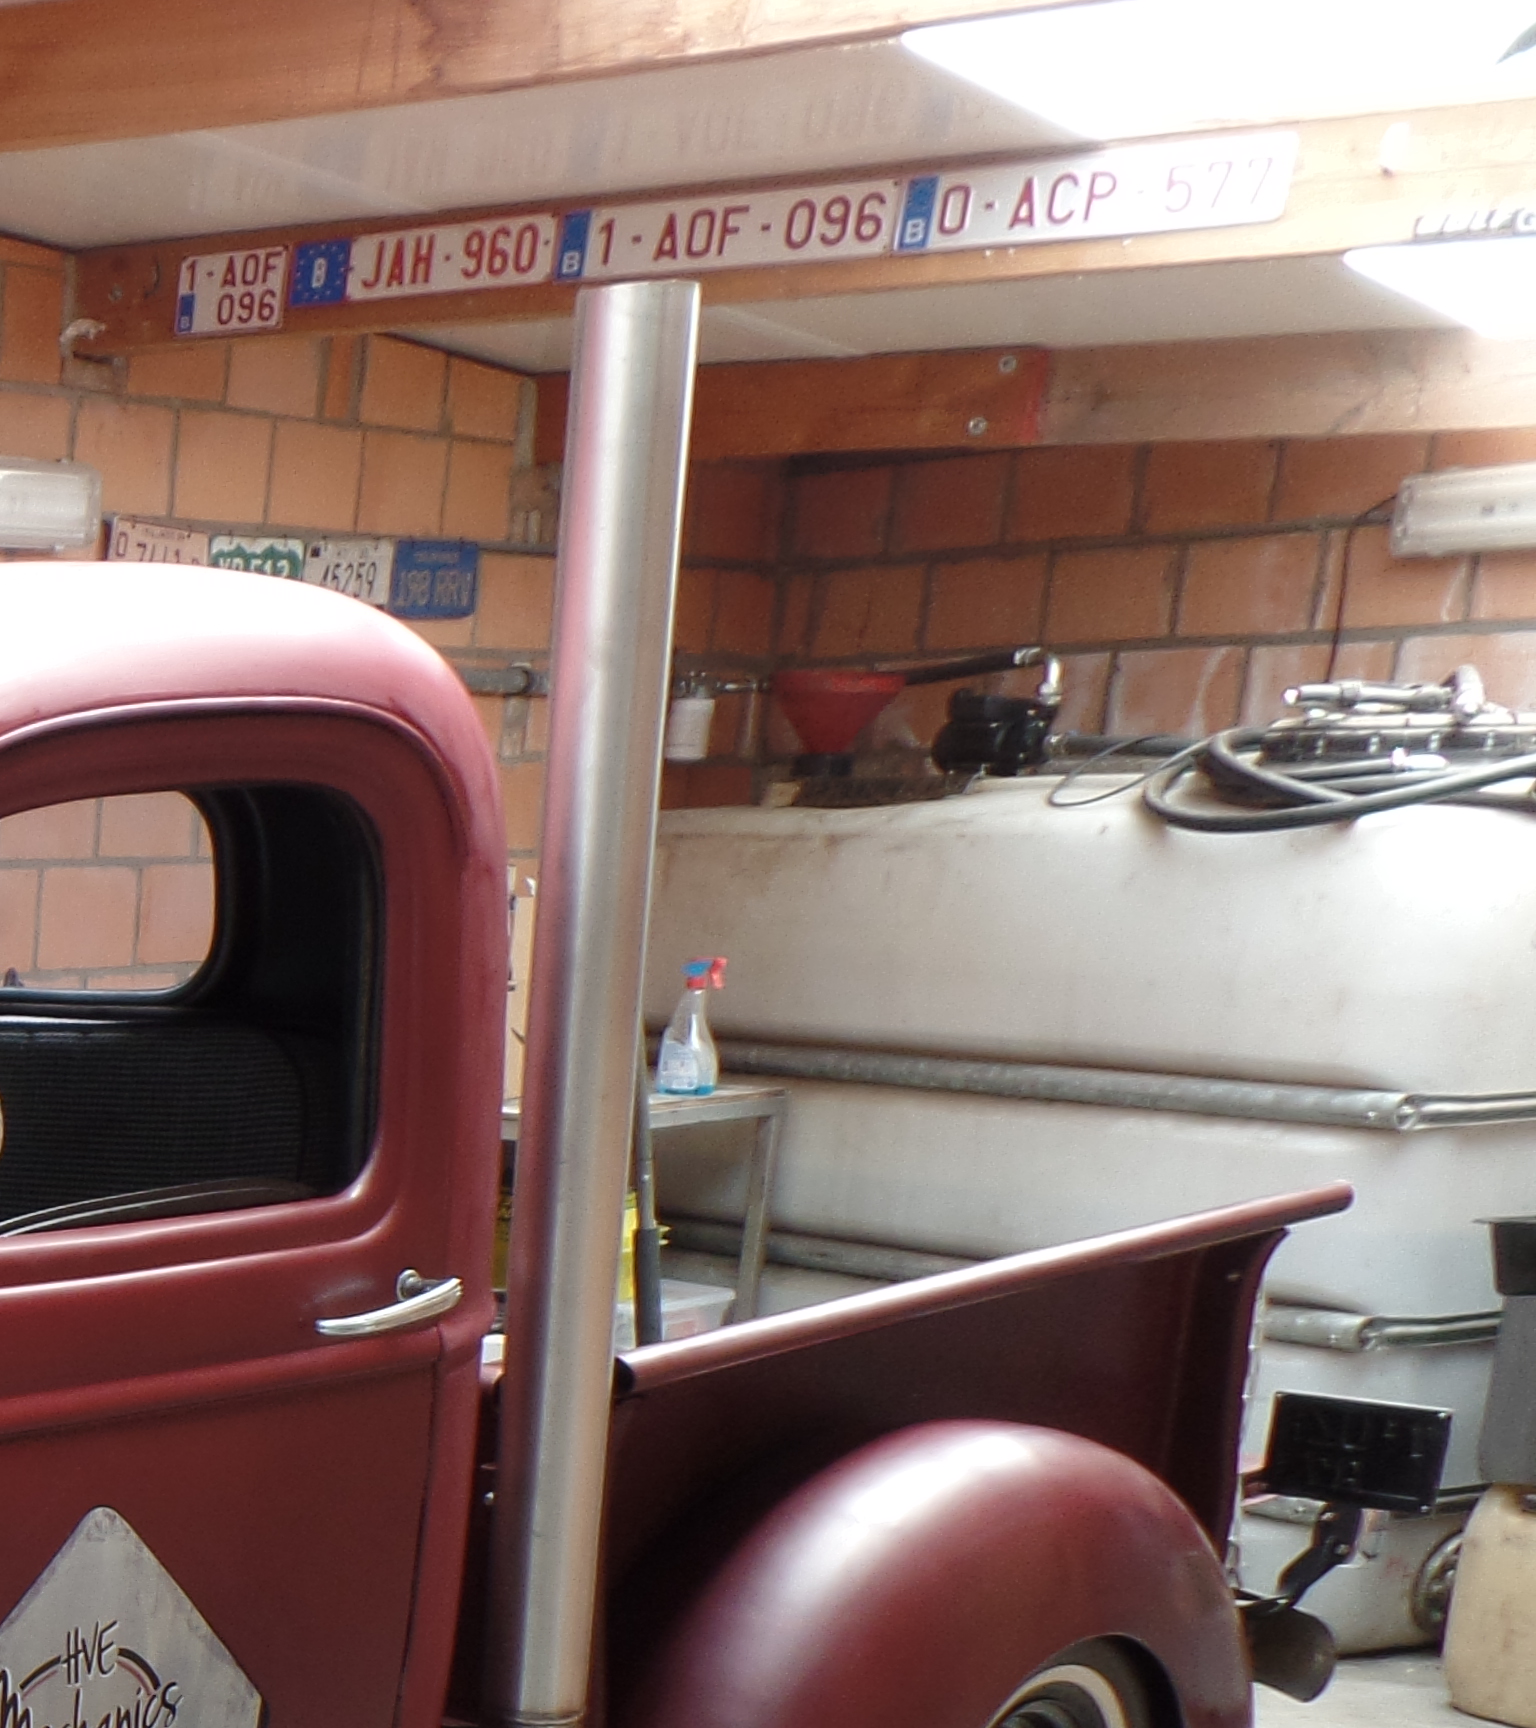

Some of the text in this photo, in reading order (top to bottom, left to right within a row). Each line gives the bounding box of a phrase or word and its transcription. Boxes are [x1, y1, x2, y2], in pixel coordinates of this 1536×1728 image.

[905, 217, 925, 243] B
[562, 252, 580, 274] B
[217, 289, 277, 326] 096
[60, 1620, 119, 1686] HVE
